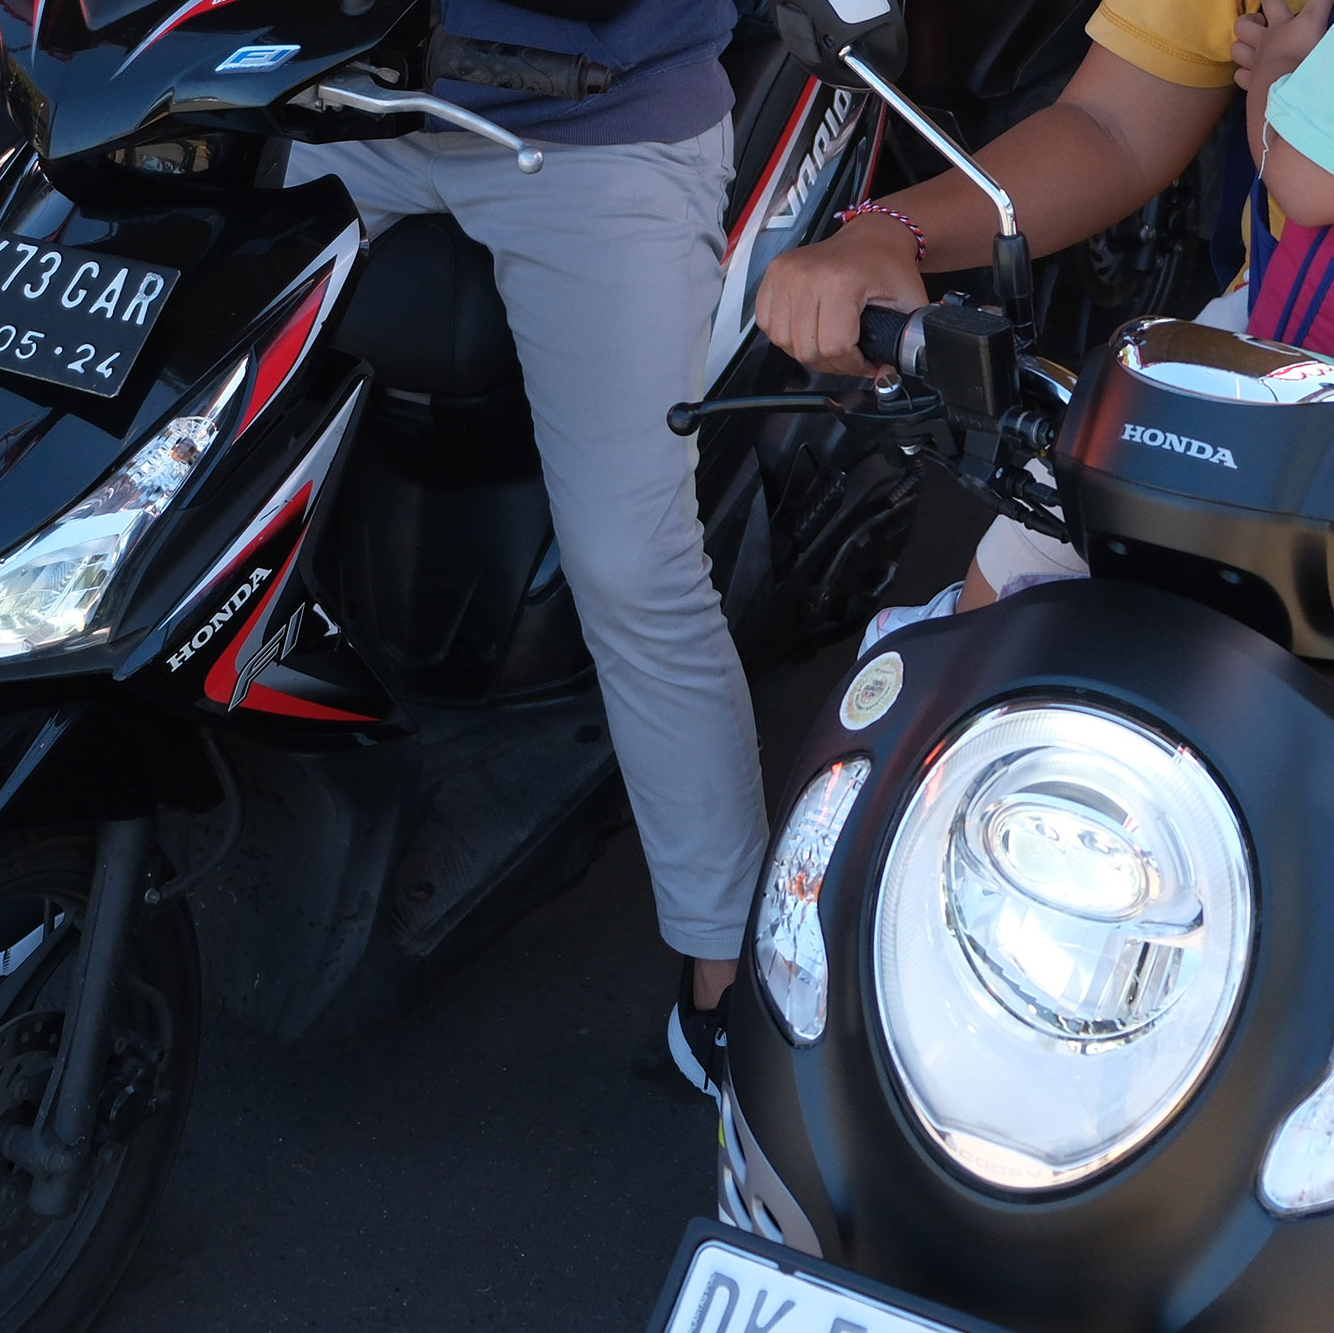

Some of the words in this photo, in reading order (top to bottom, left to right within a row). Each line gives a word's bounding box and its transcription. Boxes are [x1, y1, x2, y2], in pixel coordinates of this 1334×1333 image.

[60, 260, 165, 326] GAR
[1120, 422, 1239, 470] HONDA
[166, 566, 273, 673] HONDA
